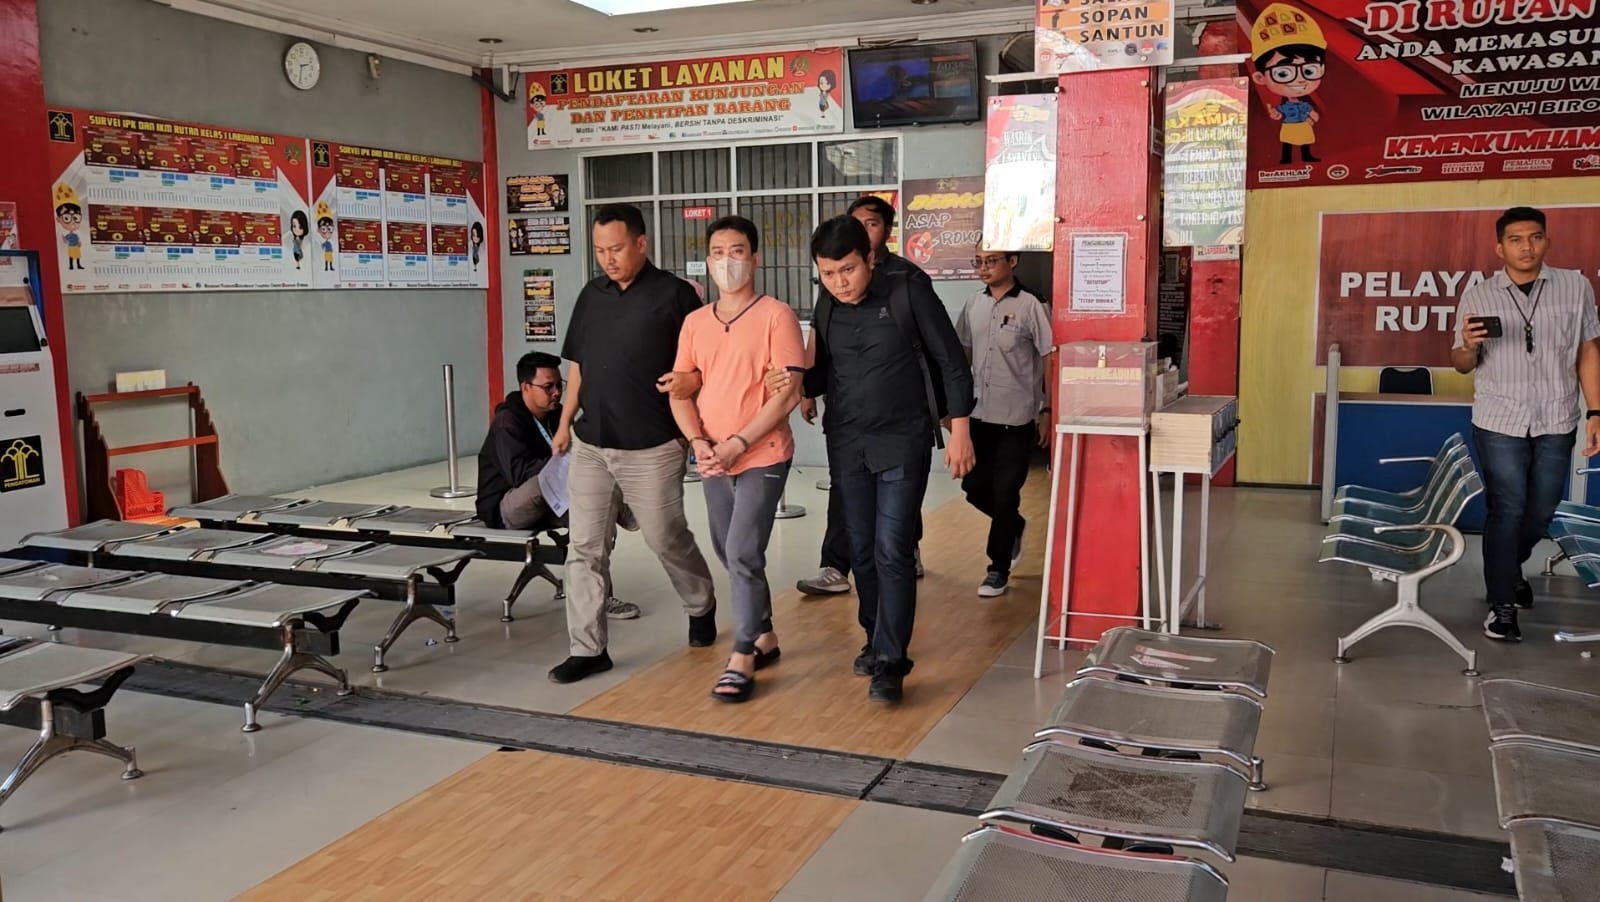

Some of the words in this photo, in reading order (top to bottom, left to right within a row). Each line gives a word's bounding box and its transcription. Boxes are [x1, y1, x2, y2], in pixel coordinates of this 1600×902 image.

[1080, 6, 1148, 25] SOPAN
[1364, 3, 1420, 35] DI
[1424, 0, 1595, 31] RUTAN
[1080, 23, 1164, 44] SANTUN
[1357, 40, 1445, 61] ANDA
[573, 67, 653, 94] LOKET
[660, 56, 785, 87] LAYANAN
[556, 89, 685, 111] PENDAFTARAN
[689, 81, 806, 102] KUNJUNGAN
[1460, 77, 1566, 99] MENUJU
[570, 109, 607, 125] DAN
[610, 103, 710, 122] PENITIPAN
[714, 97, 792, 115] BARANG
[1421, 101, 1535, 121] WILAYAH
[89, 115, 121, 128] SURVEI
[122, 119, 137, 130] IPK
[138, 121, 154, 132] DAN
[156, 123, 173, 134] IKM
[174, 125, 200, 137] RUTAN
[200, 128, 223, 140] KELAS
[228, 132, 260, 144] LABUHAN
[260, 135, 275, 146] DELI
[620, 123, 641, 132] PASTI
[641, 120, 673, 131] Melayani,
[675, 119, 701, 129] BERSIH
[703, 117, 727, 127] TANPA
[1384, 126, 1600, 160] KEMENKUMHAM
[1504, 159, 1553, 168] PEMAJUAN
[685, 208, 706, 218] LOKET
[905, 213, 952, 230] ASAP
[1340, 271, 1500, 297] PELAYA
[1375, 306, 1458, 331] RUT
